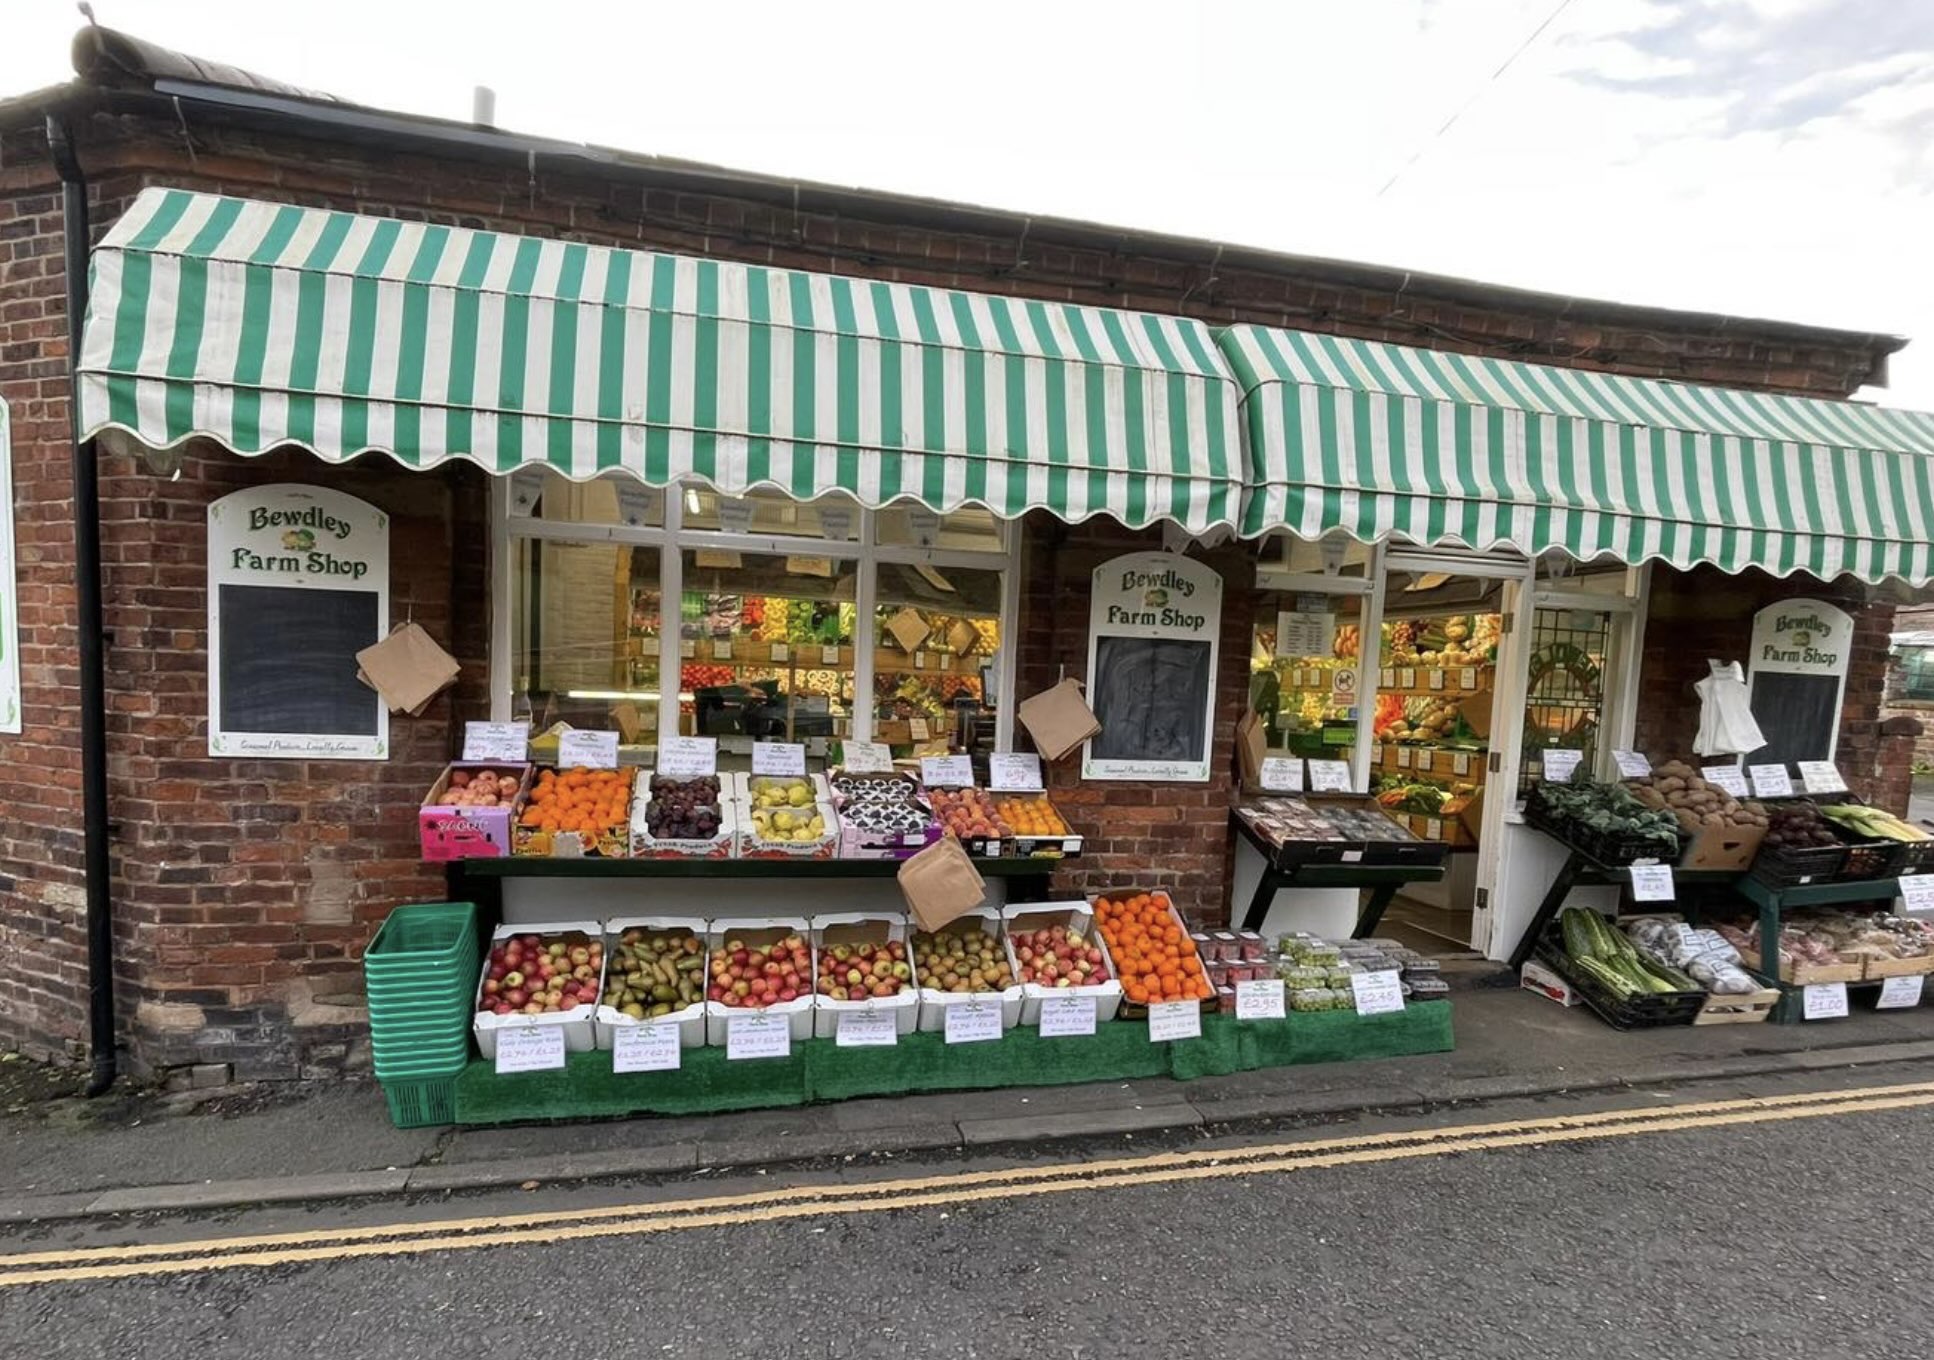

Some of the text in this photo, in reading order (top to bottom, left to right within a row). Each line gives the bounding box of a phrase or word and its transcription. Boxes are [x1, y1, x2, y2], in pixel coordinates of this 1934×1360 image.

[249, 505, 351, 540] Bewdley
[231, 547, 368, 580] Farm Shop
[1121, 569, 1195, 598] Bewdley
[1107, 605, 1205, 632] Farm Shop
[1775, 614, 1832, 638] Bewdley
[1762, 644, 1837, 667] Farm Shop
